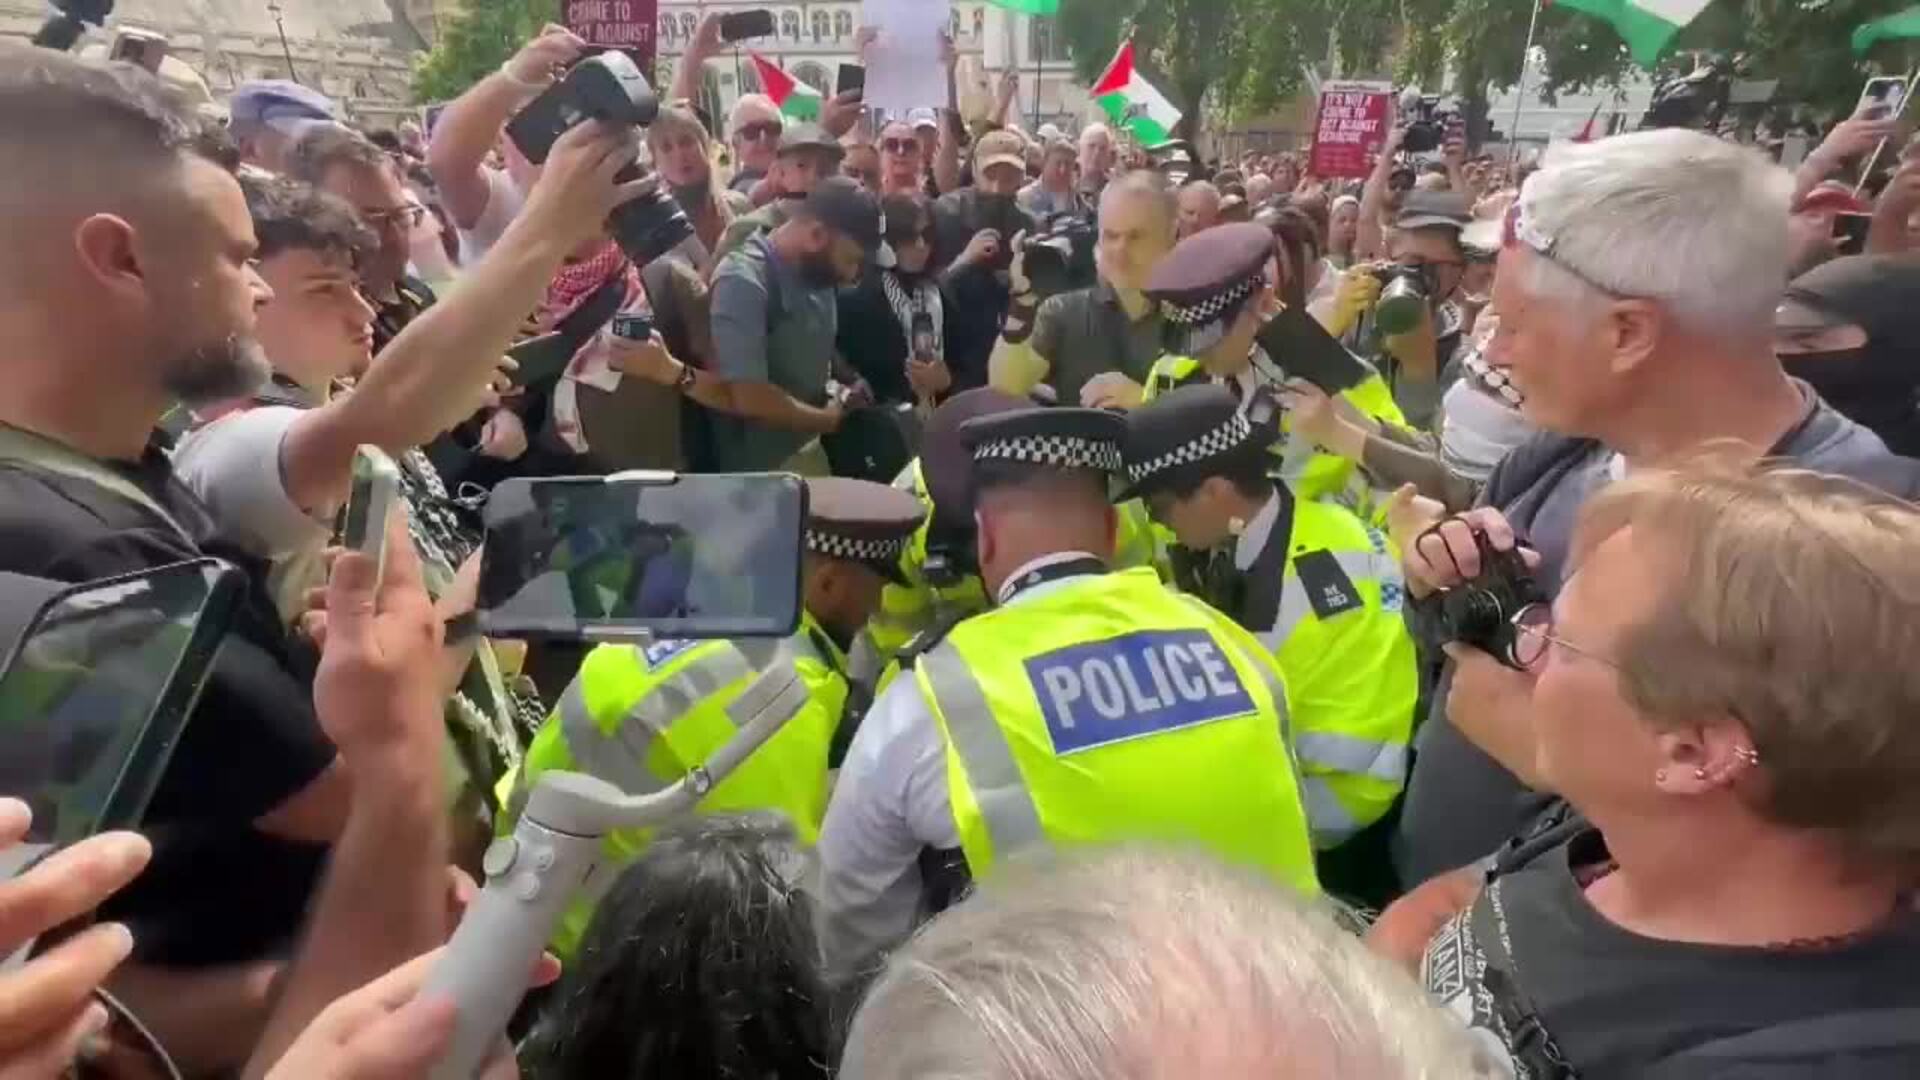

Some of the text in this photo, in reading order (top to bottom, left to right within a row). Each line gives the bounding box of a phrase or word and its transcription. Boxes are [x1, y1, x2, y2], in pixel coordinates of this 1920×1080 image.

[613, 0, 631, 21] TO
[595, 23, 649, 42] AGAINST
[1345, 93, 1365, 108] NOT
[1364, 95, 1373, 107] A
[1353, 107, 1366, 120] TO
[1320, 119, 1379, 133] ACT AGAINST
[1042, 642, 1237, 728] POLICE
